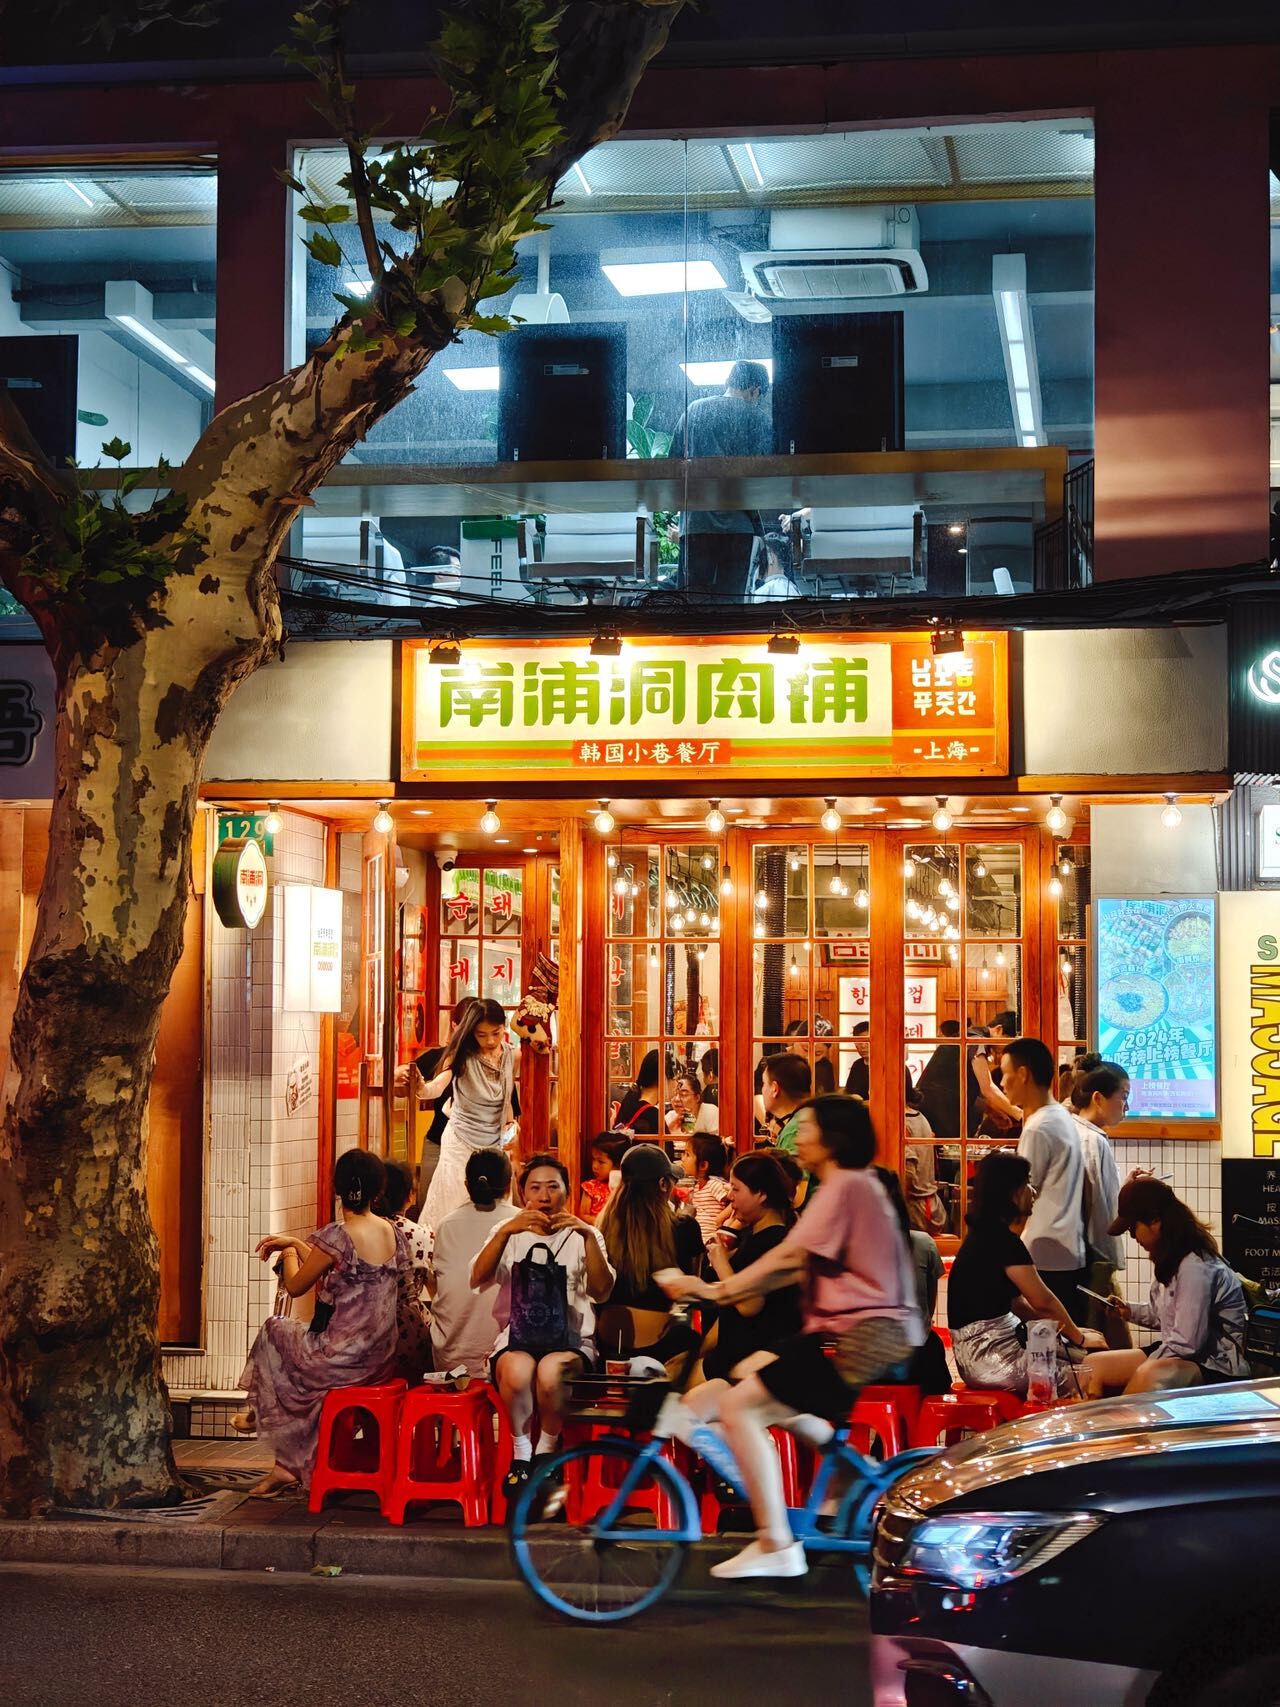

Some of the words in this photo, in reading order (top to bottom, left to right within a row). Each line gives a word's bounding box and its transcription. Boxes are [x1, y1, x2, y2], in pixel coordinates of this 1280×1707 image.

[579, 741, 721, 764] 韩国小巷餐厅
[226, 820, 266, 840] 129
[1125, 1026, 1185, 1050] 2024年
[1244, 1248, 1269, 1257] FOOT
